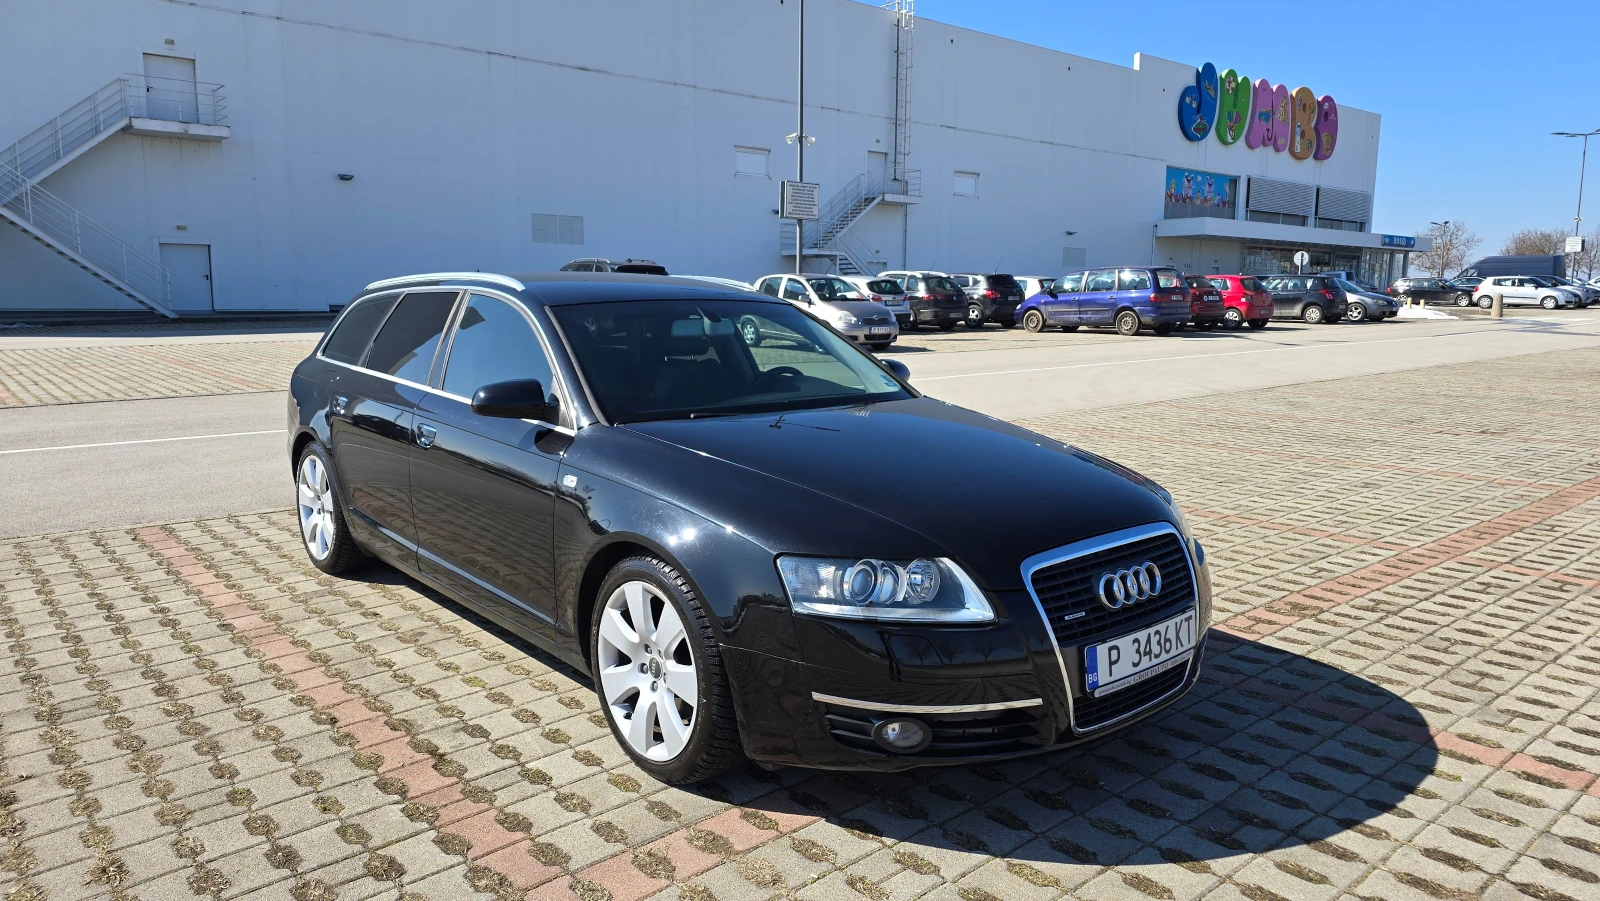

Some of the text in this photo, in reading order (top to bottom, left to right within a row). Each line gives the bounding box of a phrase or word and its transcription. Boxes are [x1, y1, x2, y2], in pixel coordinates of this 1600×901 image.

[1178, 62, 1338, 160] JUMBO
[1107, 644, 1121, 677] P
[1088, 672, 1098, 684] BG
